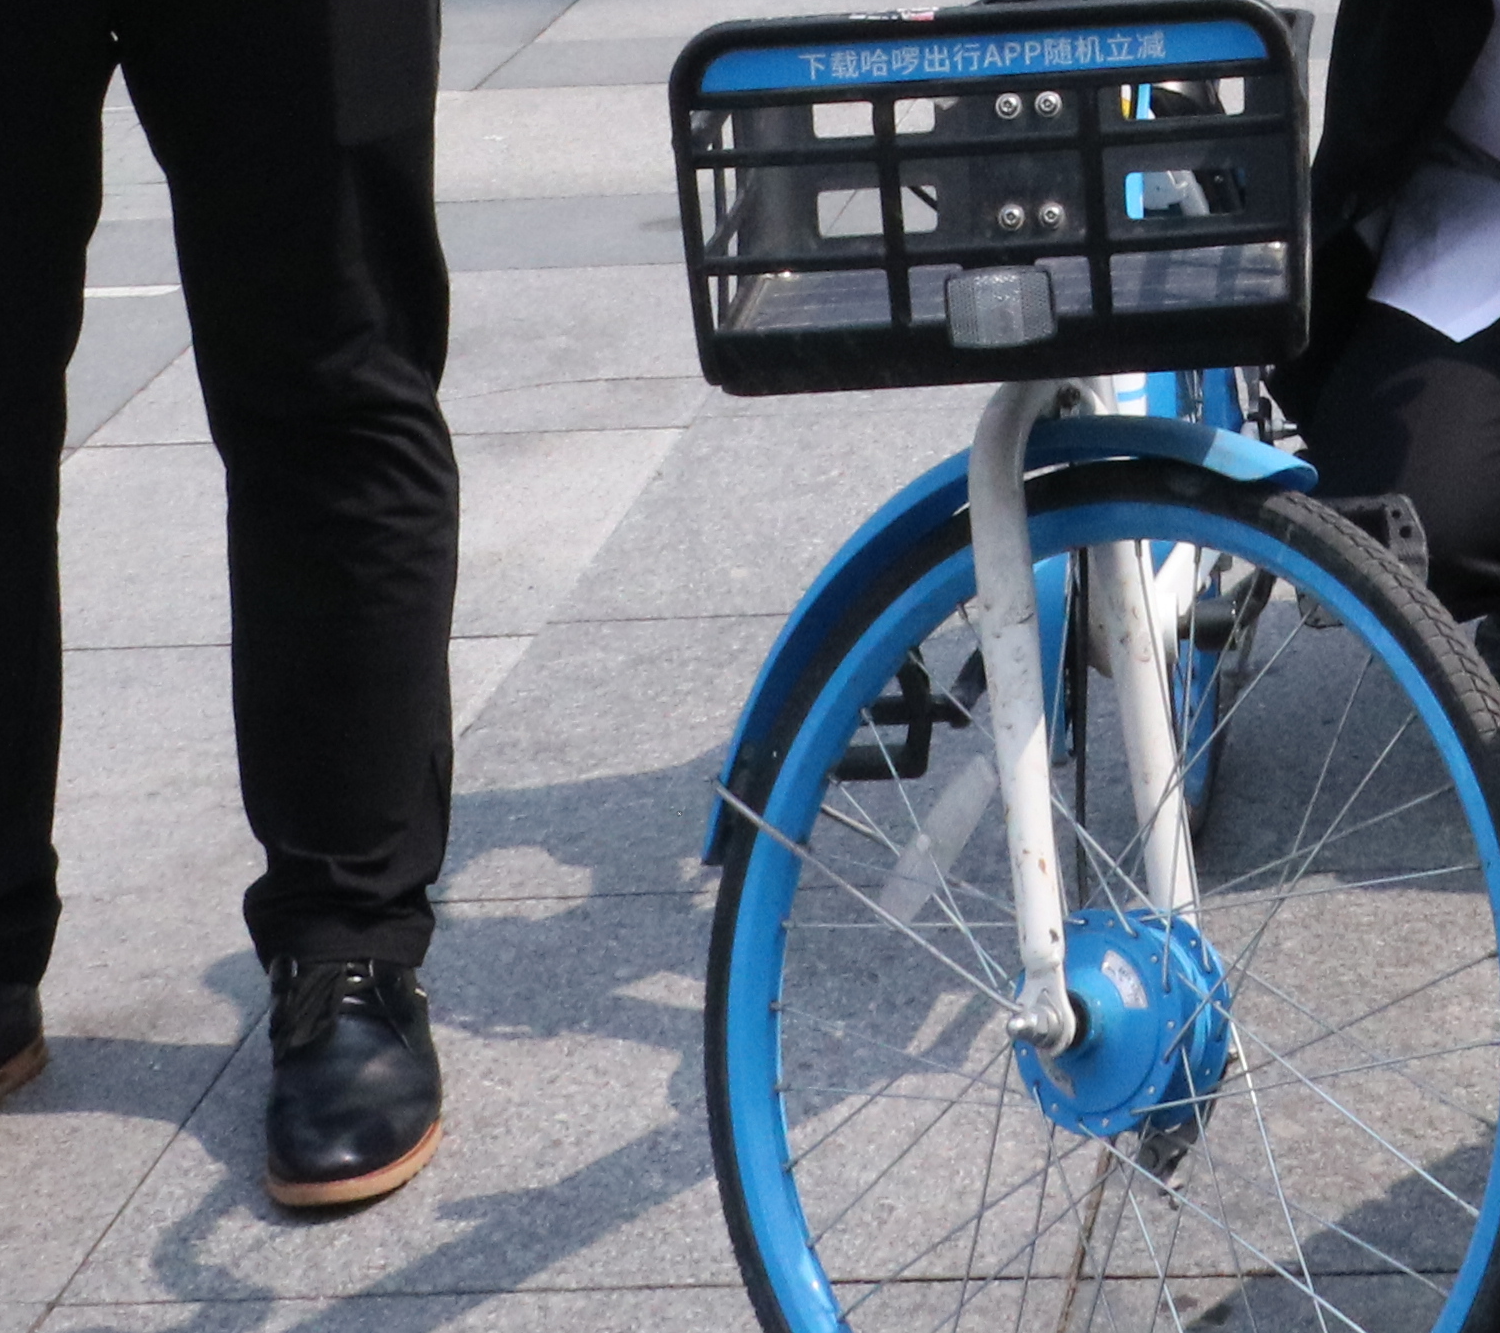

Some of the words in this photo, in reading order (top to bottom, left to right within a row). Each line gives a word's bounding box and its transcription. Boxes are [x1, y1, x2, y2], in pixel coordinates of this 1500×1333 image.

[799, 30, 1167, 79] 下载哈啰出行APP随机立减
